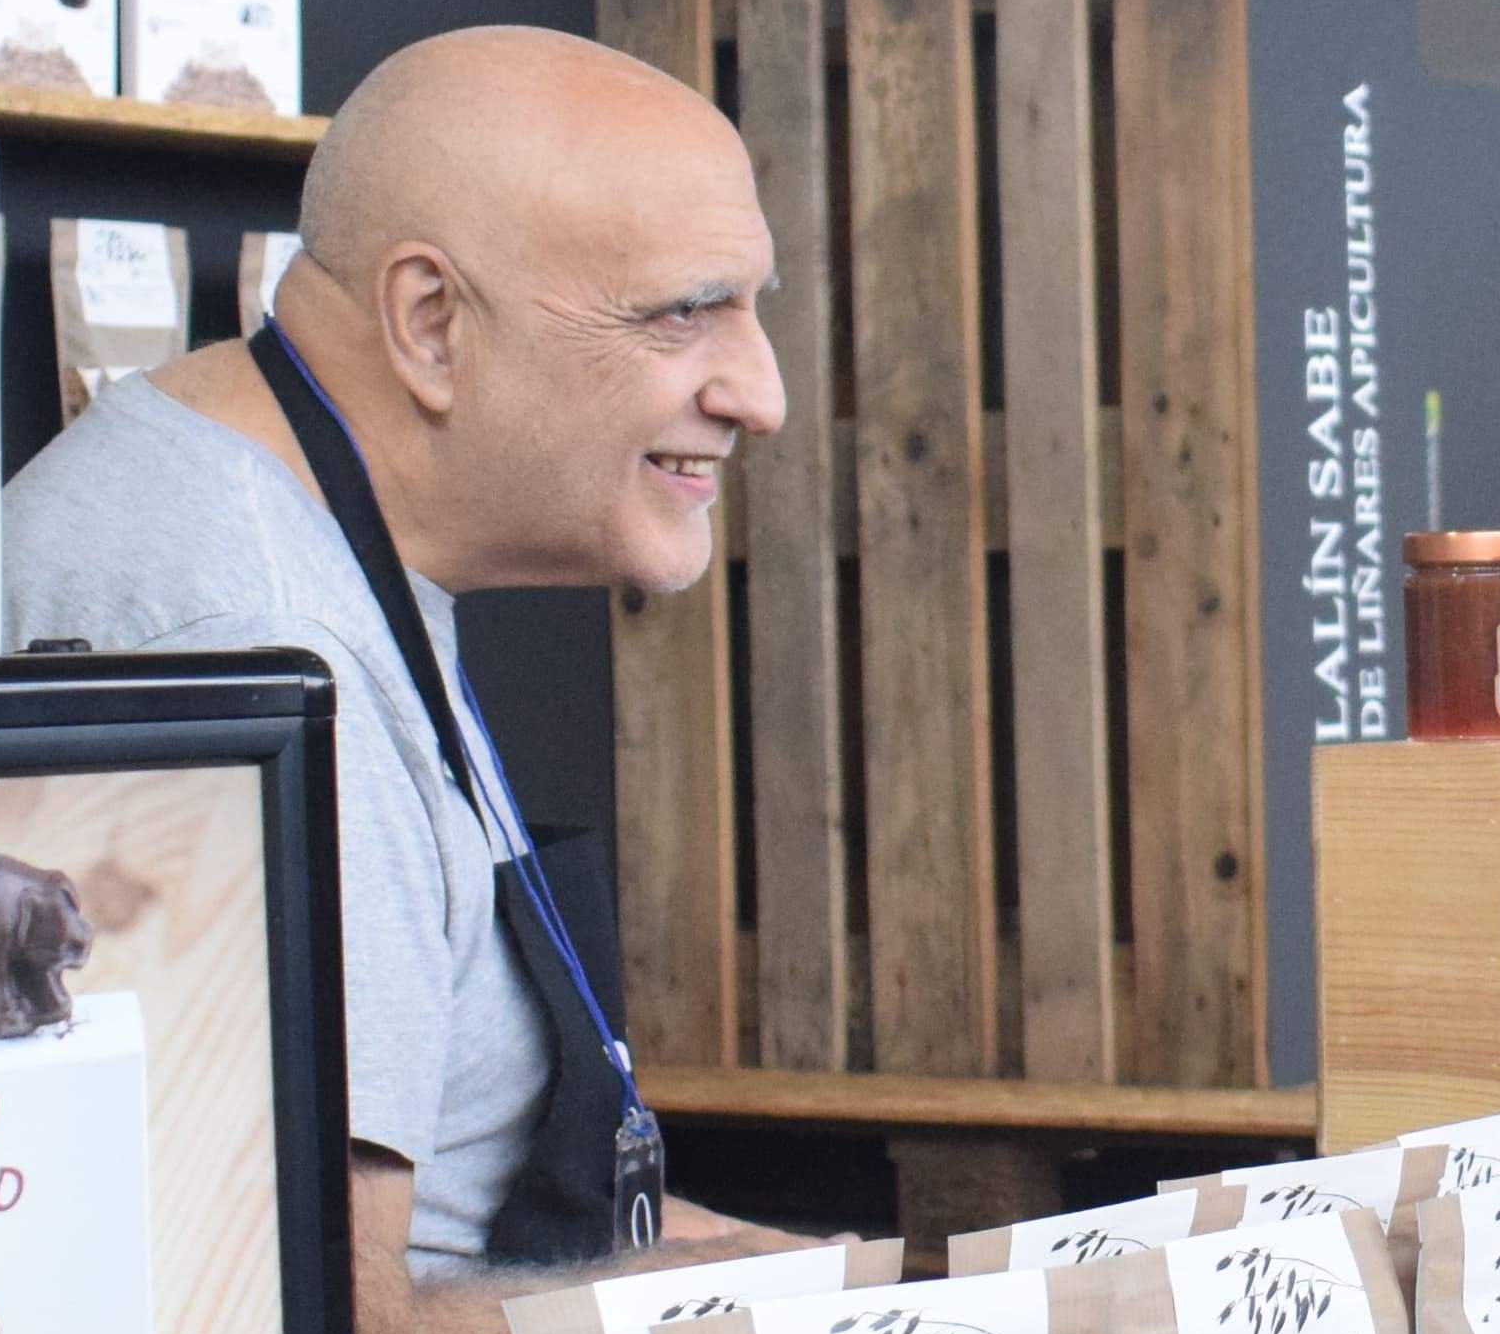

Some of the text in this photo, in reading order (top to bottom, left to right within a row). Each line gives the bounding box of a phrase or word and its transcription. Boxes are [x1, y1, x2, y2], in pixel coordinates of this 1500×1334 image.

[1301, 306, 1350, 741] LALÍN SABE
[1343, 82, 1387, 739] DE LIÑARES APICULTURA
